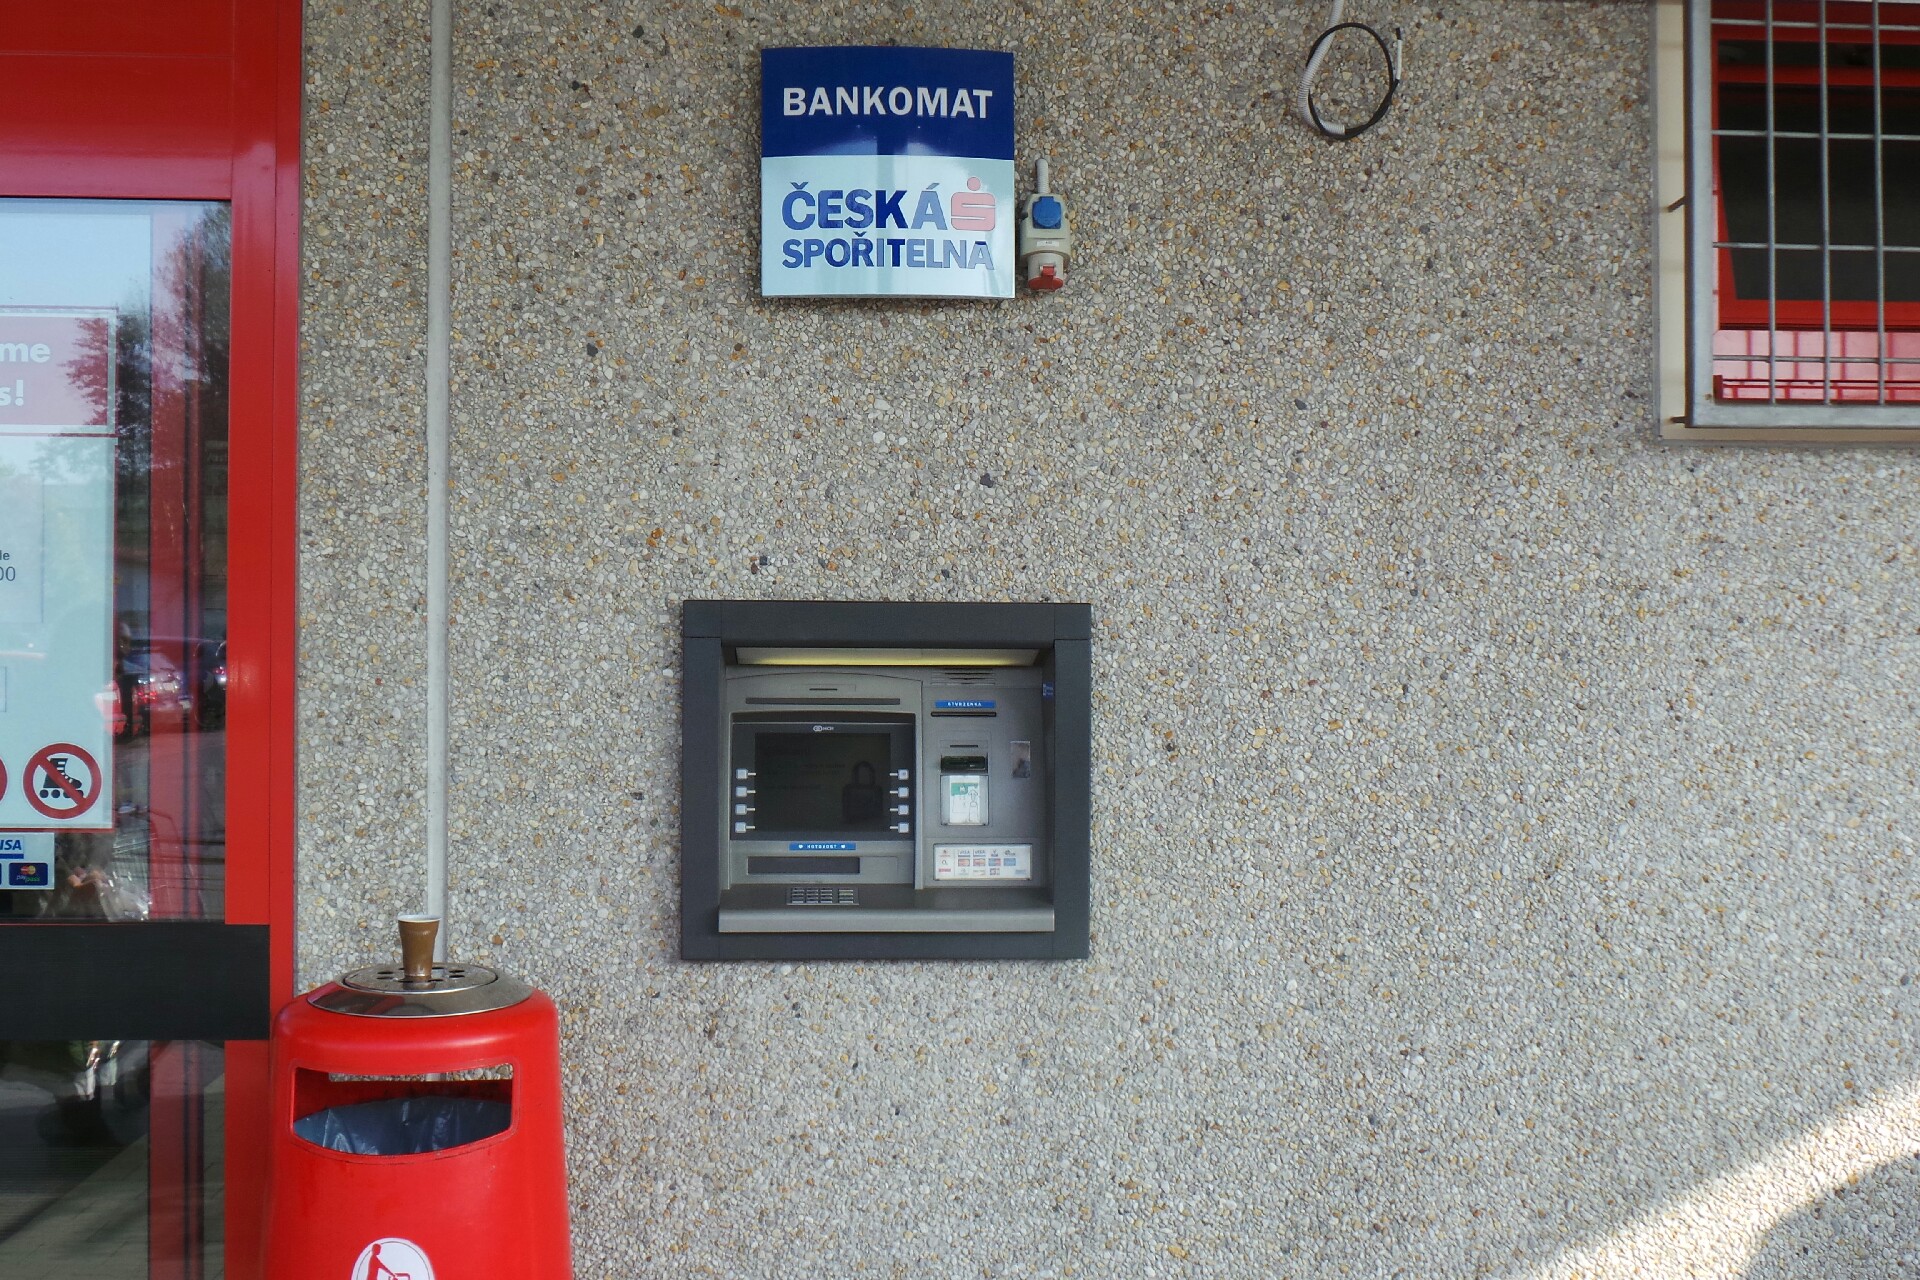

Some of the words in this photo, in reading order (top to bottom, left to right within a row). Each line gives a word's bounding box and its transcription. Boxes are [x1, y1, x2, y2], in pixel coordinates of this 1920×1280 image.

[783, 86, 993, 119] BANKOMAT
[781, 181, 948, 231] ČESKÁ
[782, 231, 995, 270] SPOŘITELNA
